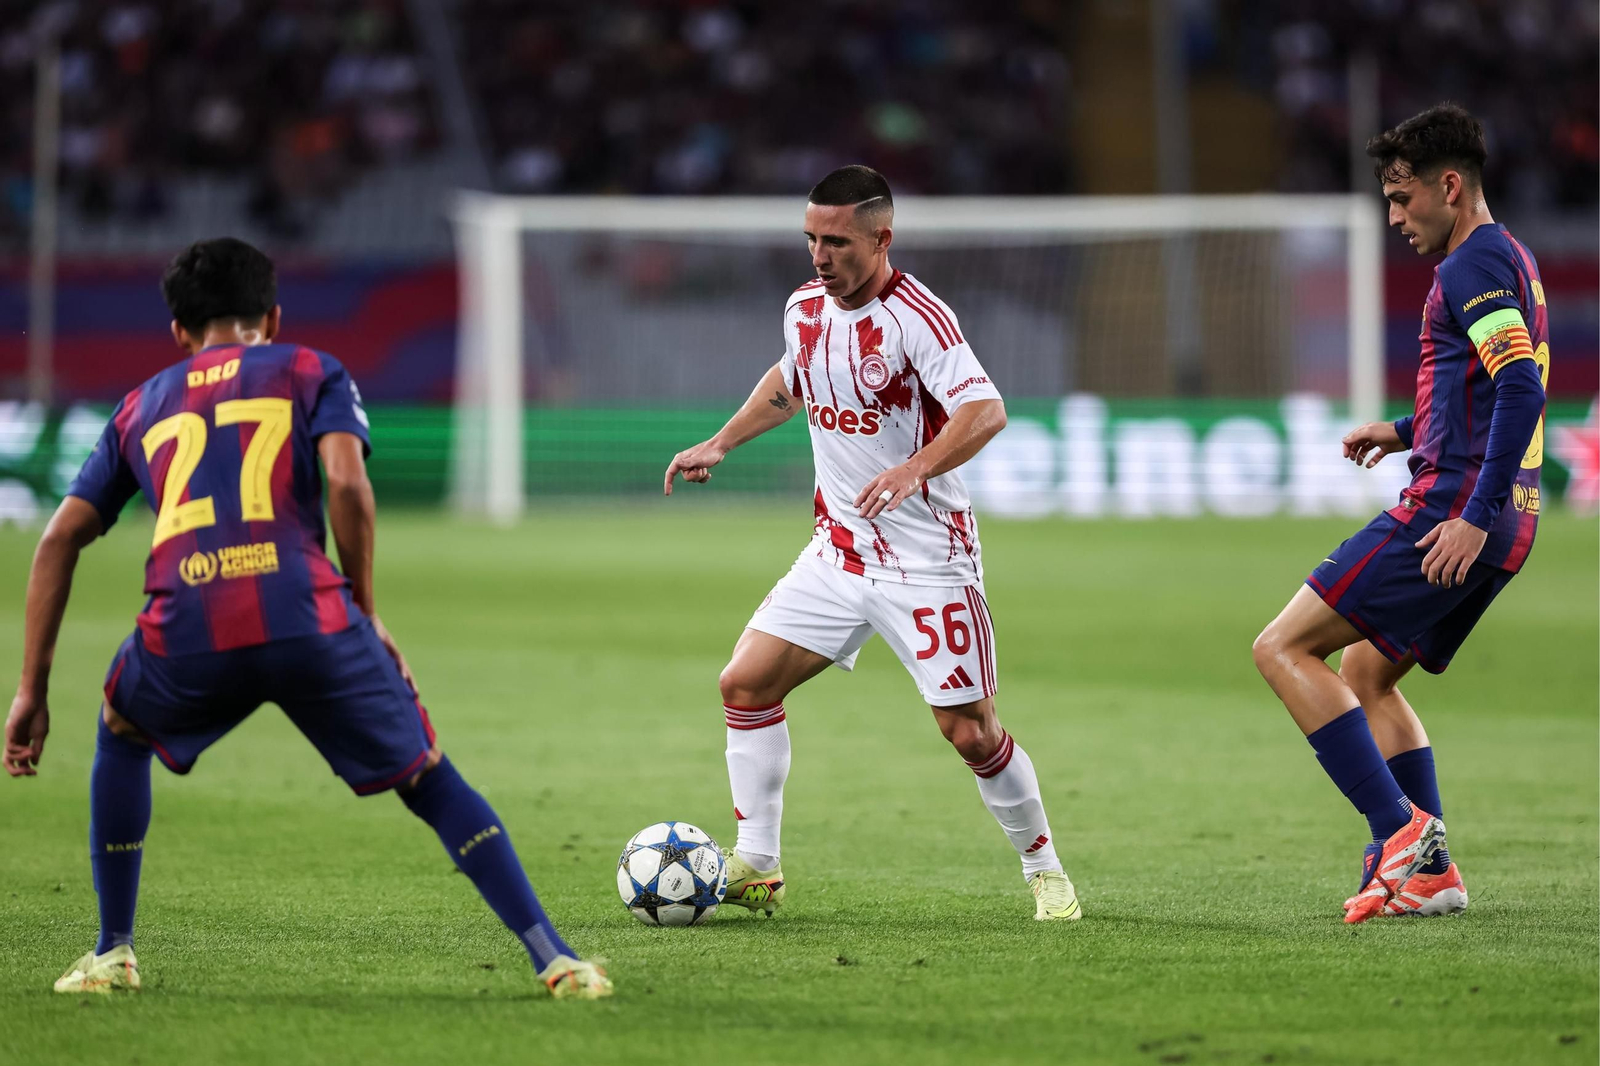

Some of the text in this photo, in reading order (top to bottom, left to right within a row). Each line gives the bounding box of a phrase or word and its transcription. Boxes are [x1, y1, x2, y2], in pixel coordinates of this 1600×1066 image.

[1462, 289, 1505, 313] AMBILIGHT
[187, 358, 241, 388] DRO
[806, 396, 880, 435] iroes
[141, 397, 293, 549] 27
[912, 602, 972, 660] 56
